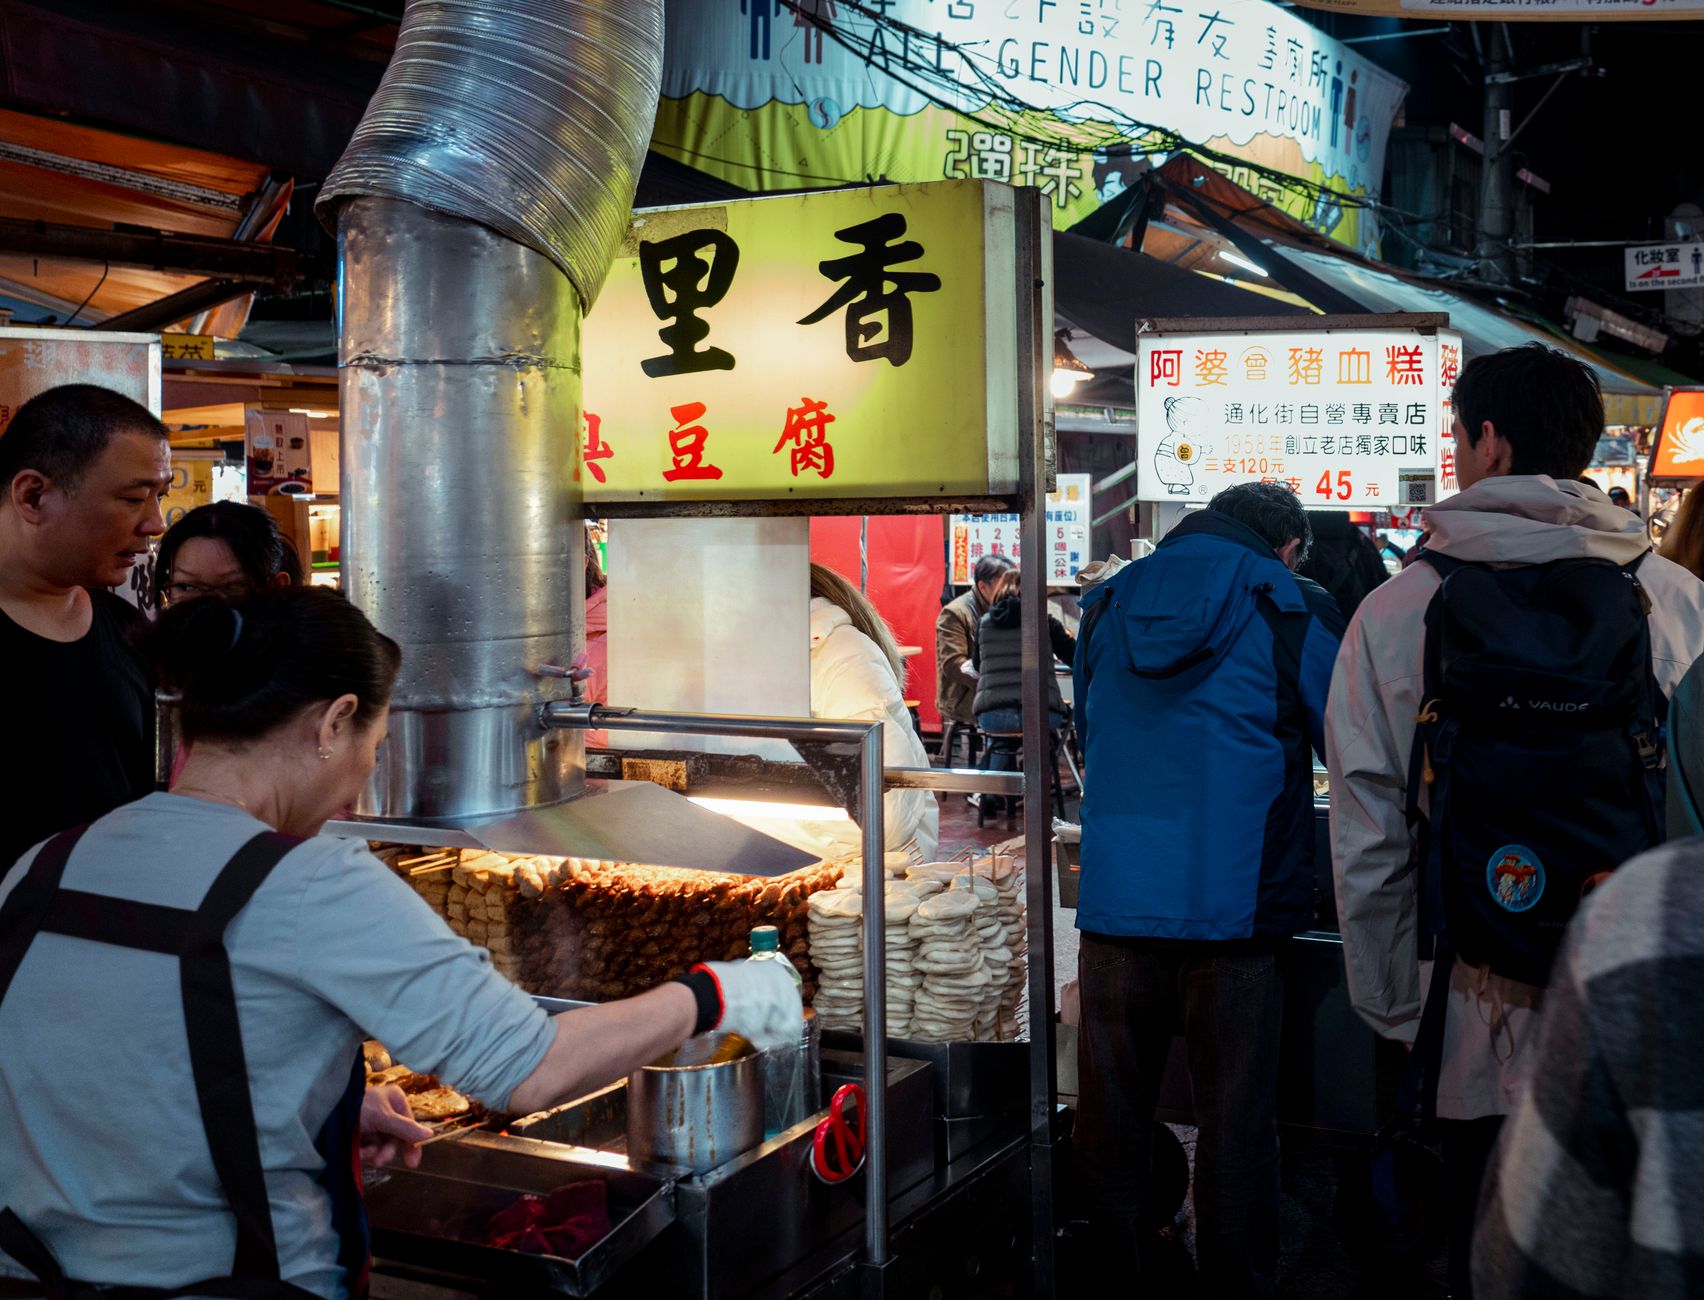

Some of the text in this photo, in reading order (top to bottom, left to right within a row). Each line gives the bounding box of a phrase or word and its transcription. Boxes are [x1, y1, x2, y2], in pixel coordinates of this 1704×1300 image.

[866, 28, 1321, 141] ALL GENDER RESTROOM
[1225, 402, 1426, 424] 通化街自營專賣店
[1224, 434, 1426, 455] 1958年創立老店獨家口味
[1205, 458, 1285, 474] 三支120元
[1316, 470, 1352, 500] 45
[1365, 483, 1379, 496] 元
